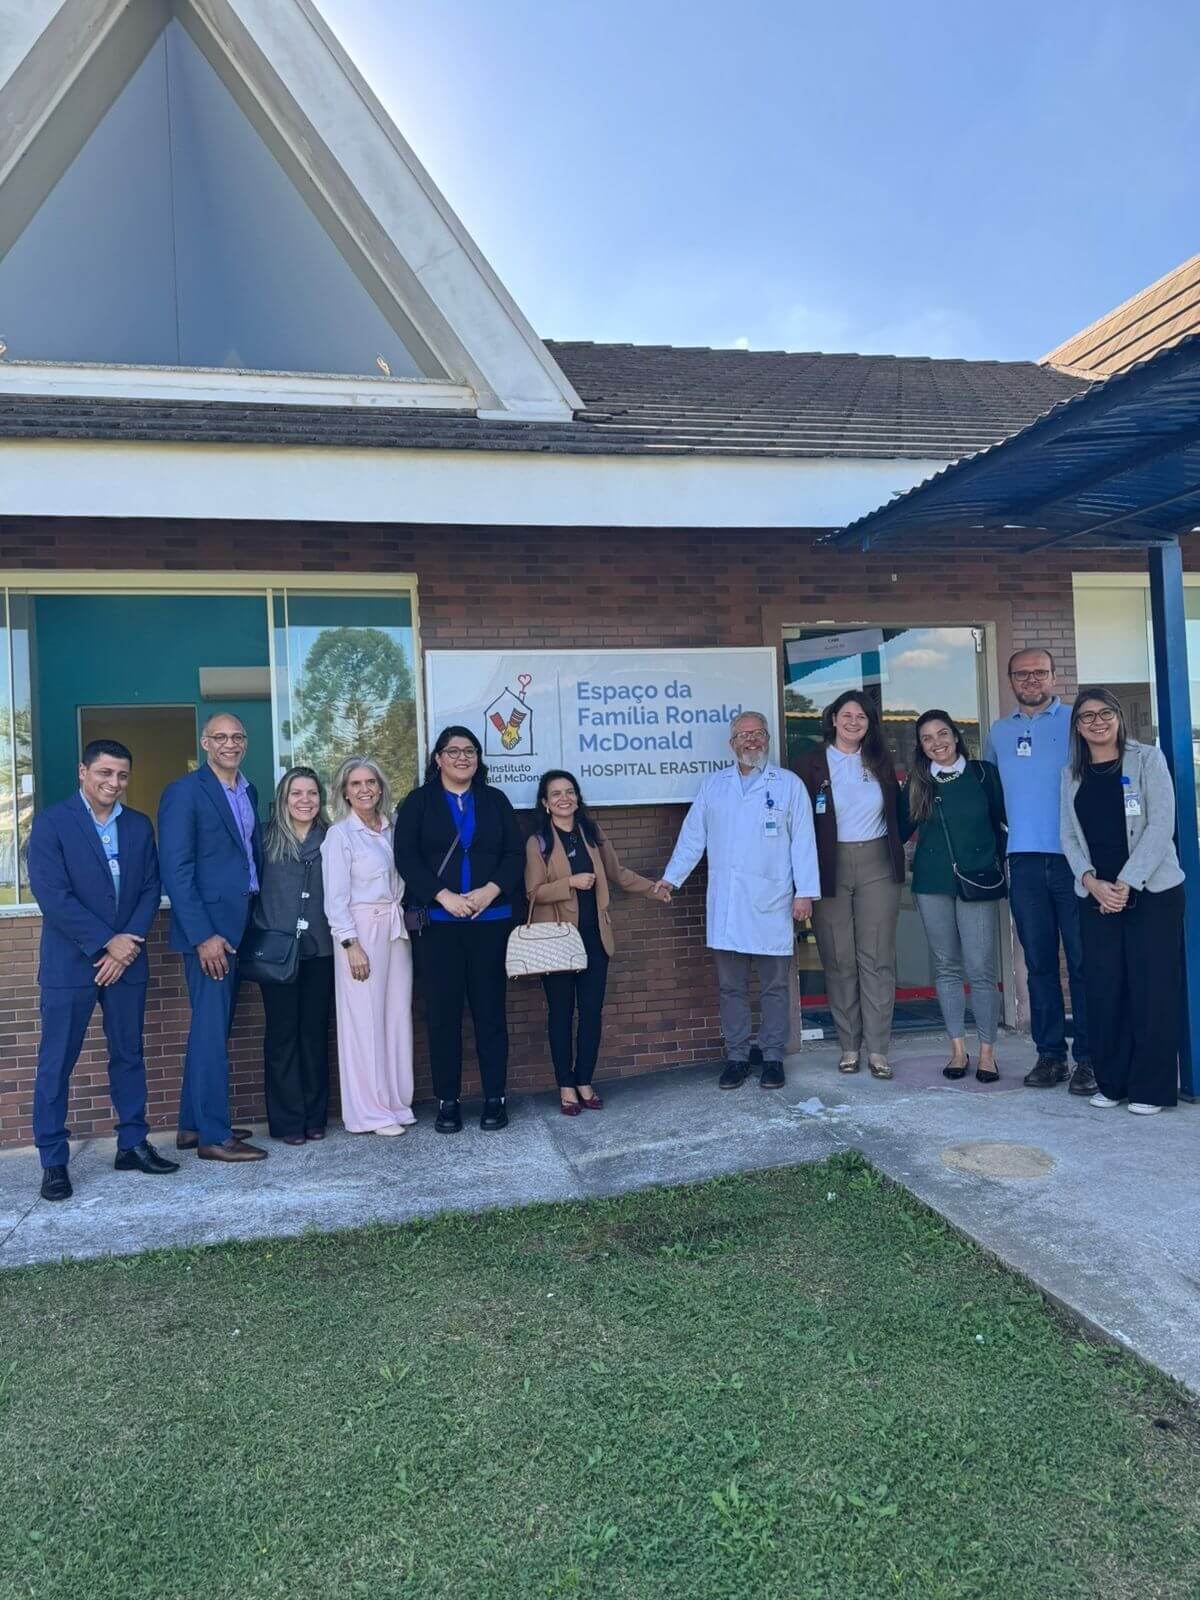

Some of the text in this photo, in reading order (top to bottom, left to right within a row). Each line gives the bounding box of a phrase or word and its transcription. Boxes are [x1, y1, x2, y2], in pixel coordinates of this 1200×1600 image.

[577, 680, 692, 704] Espaço da
[578, 704, 742, 726] Família Ronald
[579, 731, 693, 752] McDonald
[490, 763, 531, 773] Instituto
[580, 760, 735, 777] HOSPITAL ERASTINH
[487, 773, 540, 784] ald McDon
